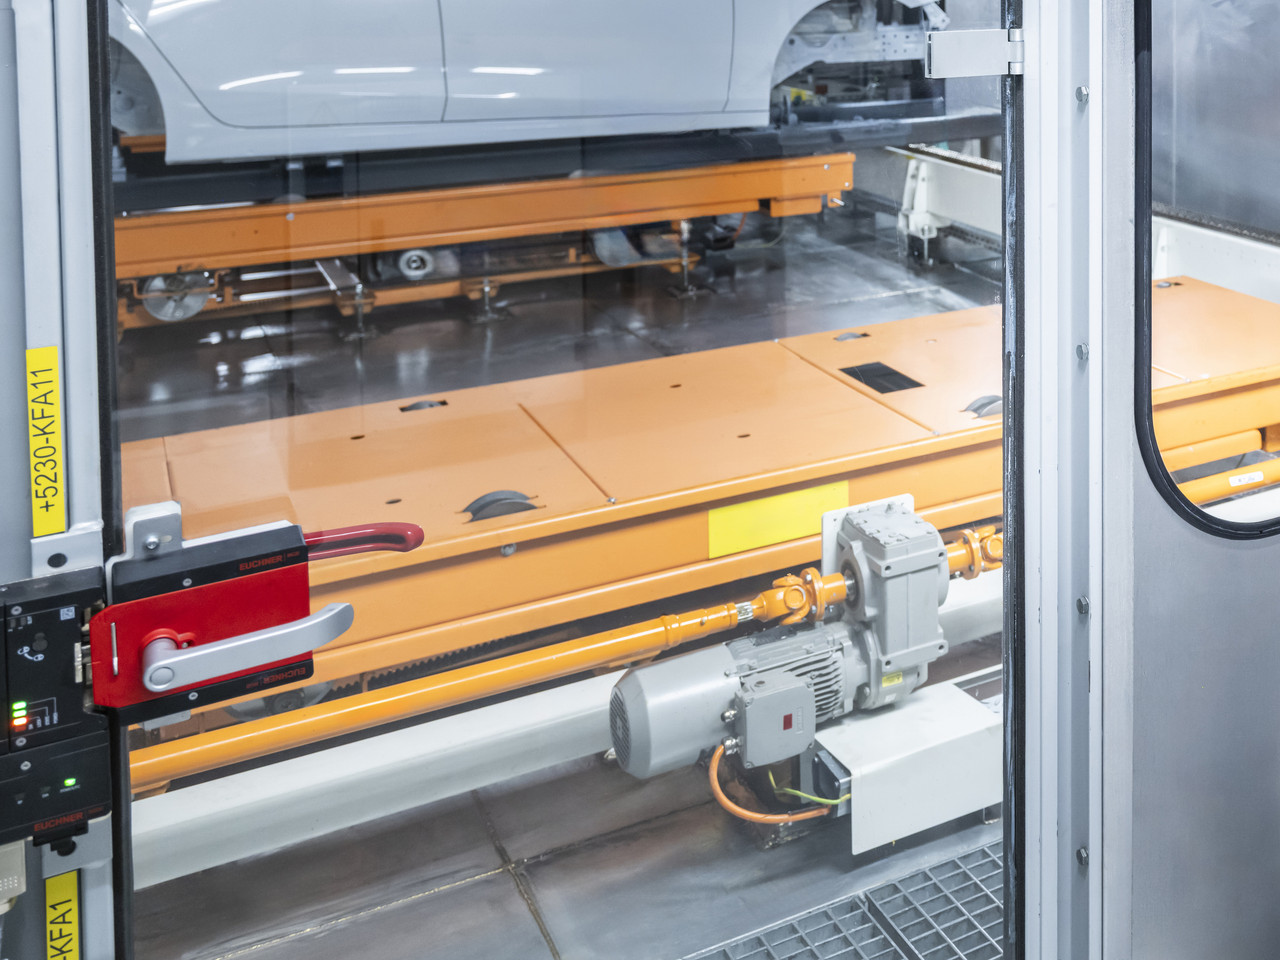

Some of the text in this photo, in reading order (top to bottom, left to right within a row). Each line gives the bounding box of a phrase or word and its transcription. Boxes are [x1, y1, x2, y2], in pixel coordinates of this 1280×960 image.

[30, 368, 58, 512] +5230-KFA11
[239, 554, 283, 571] EUCHNER
[263, 666, 306, 685] EUCHNER
[34, 812, 84, 831] EUCHNER
